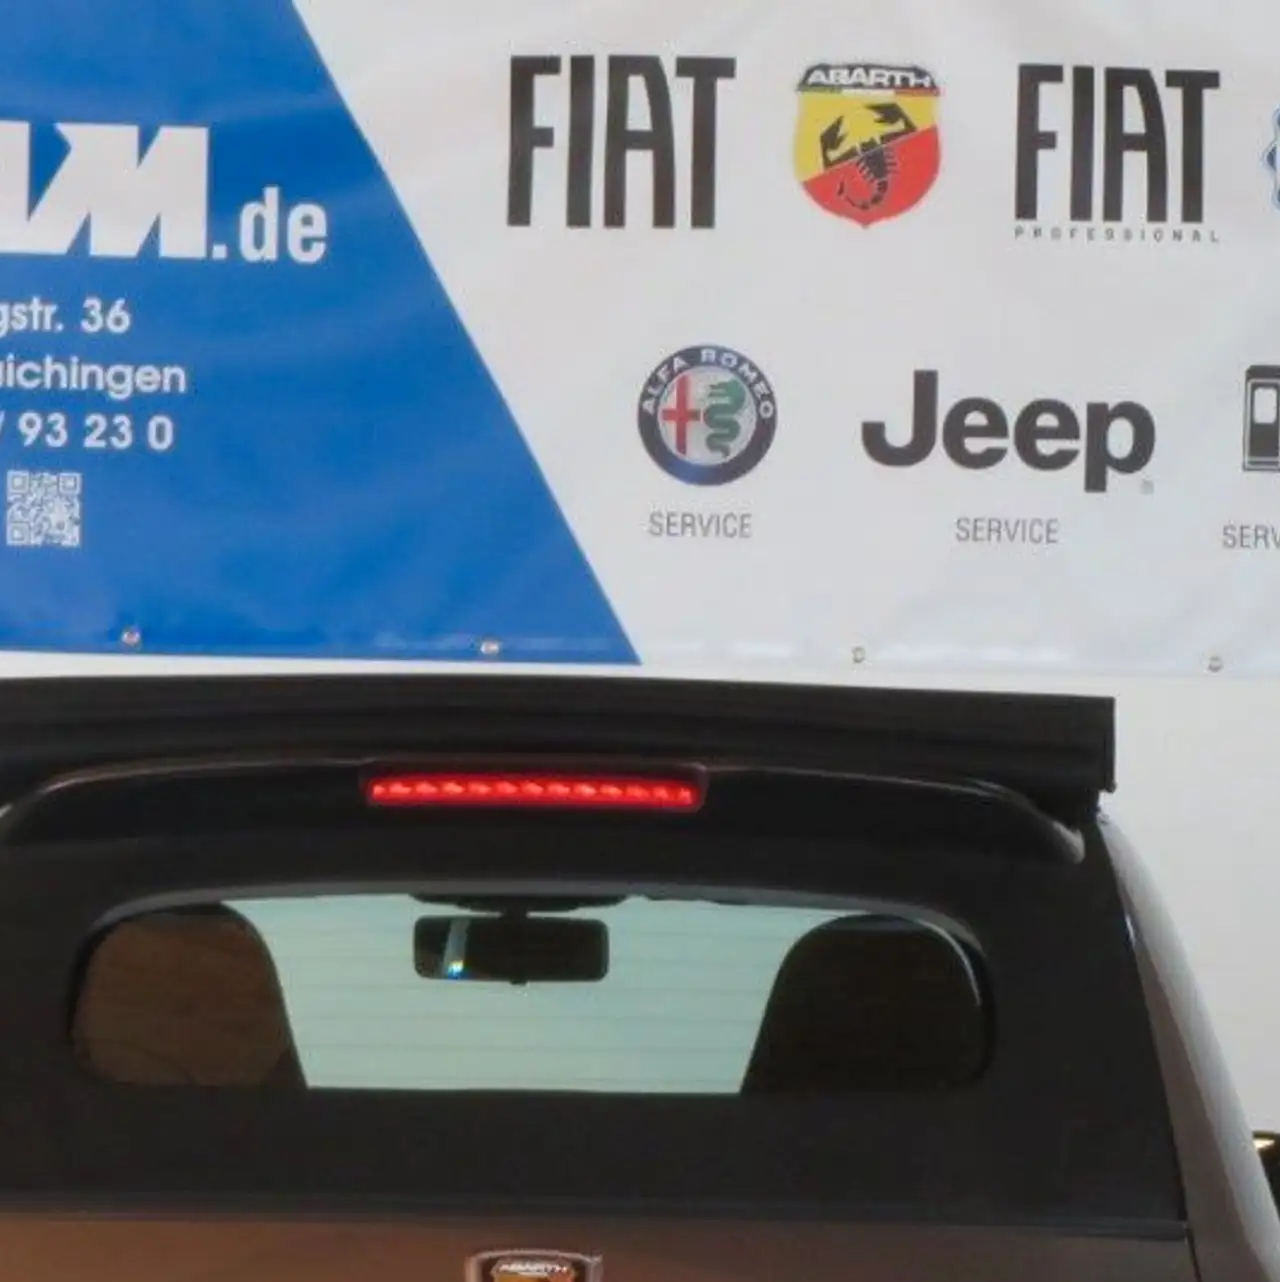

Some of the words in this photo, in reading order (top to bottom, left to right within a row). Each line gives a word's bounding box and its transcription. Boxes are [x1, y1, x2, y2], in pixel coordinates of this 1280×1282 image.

[808, 66, 931, 88] ABARTH
[507, 55, 736, 228] FIAT
[1015, 64, 1220, 223] FIAT
[81, 297, 131, 333] 36
[642, 356, 689, 415] ALFA
[700, 348, 774, 419] ROMEO
[18, 412, 68, 447] 93
[84, 414, 132, 449] 23
[148, 415, 174, 450] 0
[862, 369, 1155, 492] Jeep
[649, 511, 752, 538] SERVICE
[955, 517, 1058, 544] SERVICE
